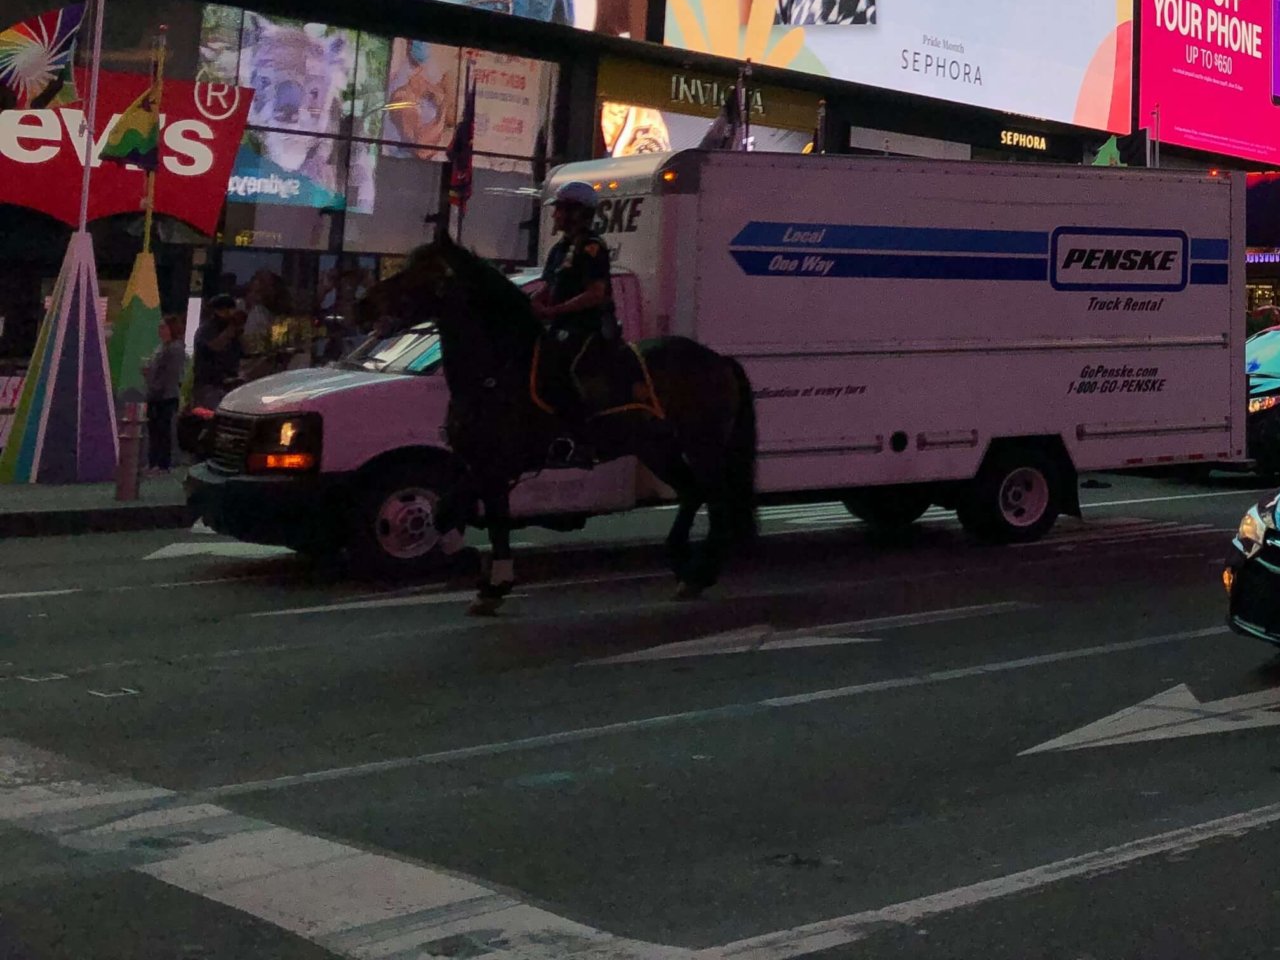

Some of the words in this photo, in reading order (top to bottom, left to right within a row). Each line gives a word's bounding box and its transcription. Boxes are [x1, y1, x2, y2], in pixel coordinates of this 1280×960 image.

[1206, 11, 1263, 60] PHONE
[901, 48, 983, 86] SEPHORA
[1185, 43, 1200, 65] UP
[1200, 48, 1213, 70] TO
[1213, 52, 1233, 76] $650
[1000, 130, 1047, 151] SEPHORA
[782, 226, 827, 244] Local
[768, 253, 799, 272] One
[801, 255, 835, 276] Way
[1061, 248, 1178, 271] PENSKE
[1087, 296, 1122, 312] Truck
[1123, 297, 1165, 312] Rental
[1079, 364, 1159, 379] GoPenske.com
[1067, 379, 1167, 395] 1-800-GO-PENSKE
